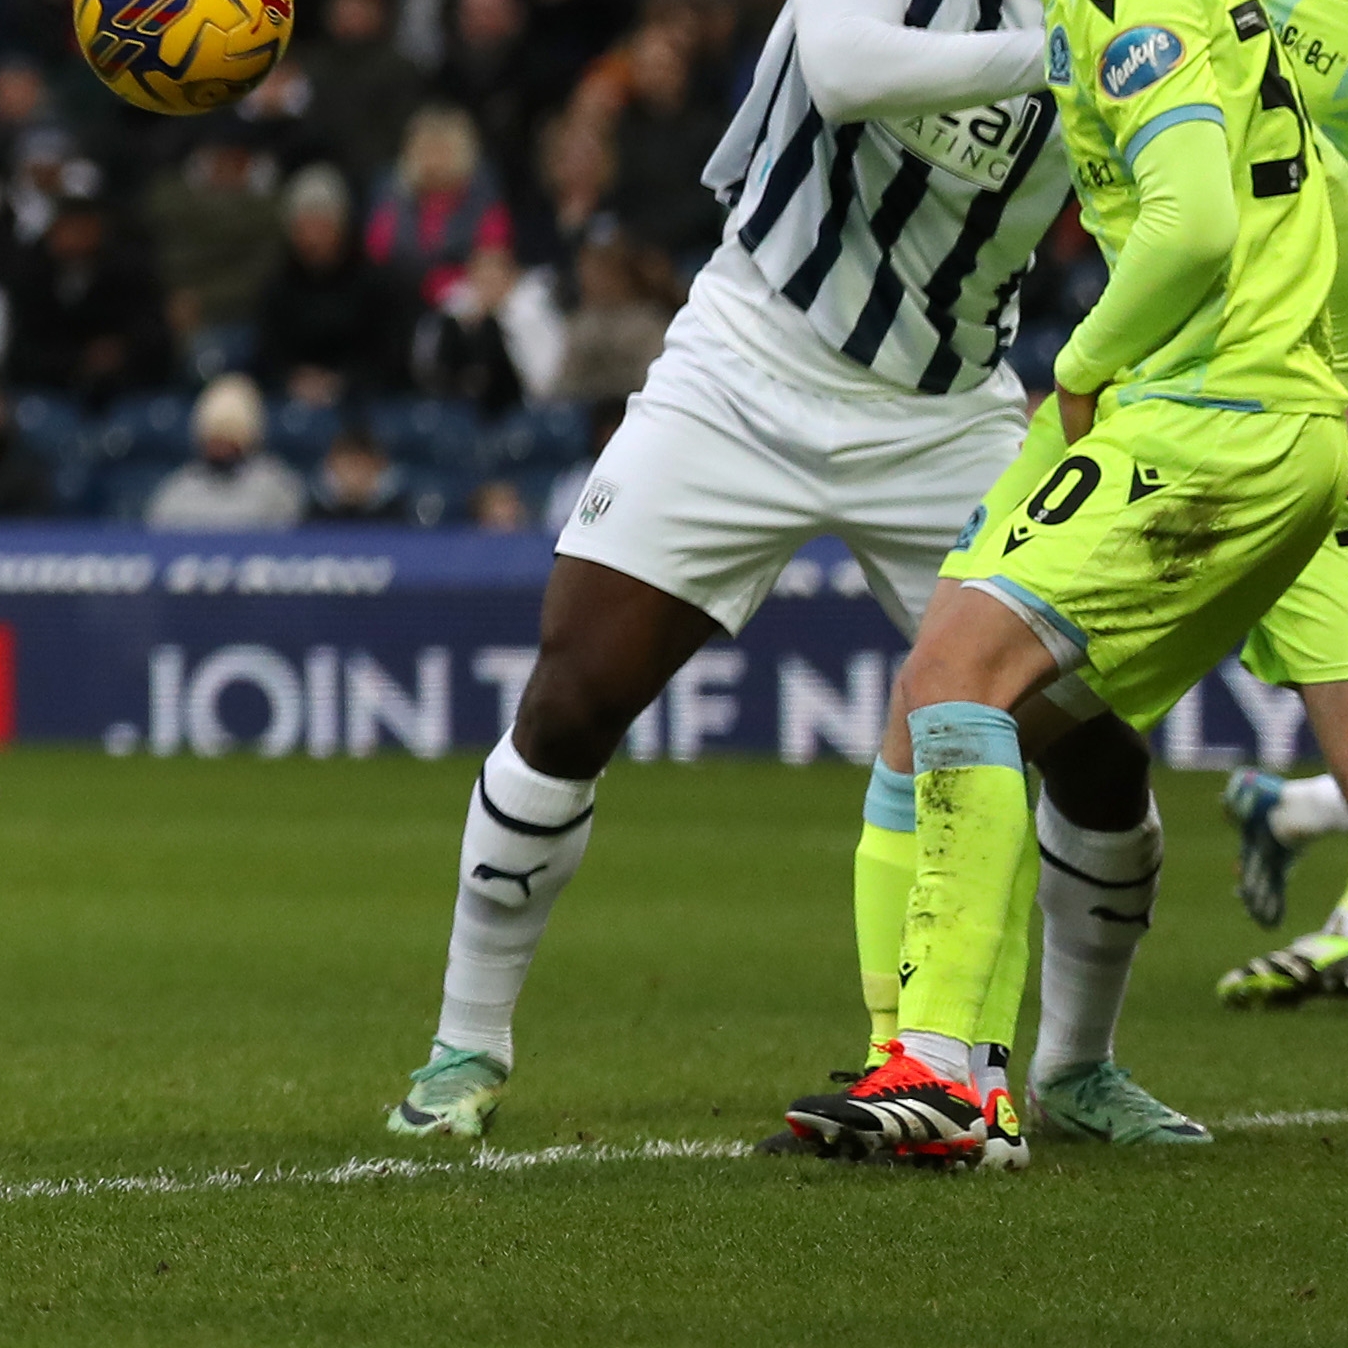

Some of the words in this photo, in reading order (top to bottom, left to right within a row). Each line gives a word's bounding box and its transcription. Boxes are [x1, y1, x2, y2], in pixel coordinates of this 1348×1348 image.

[1106, 31, 1170, 95] Venky's
[1278, 24, 1340, 76] cked
[103, 642, 452, 760] JOIN
